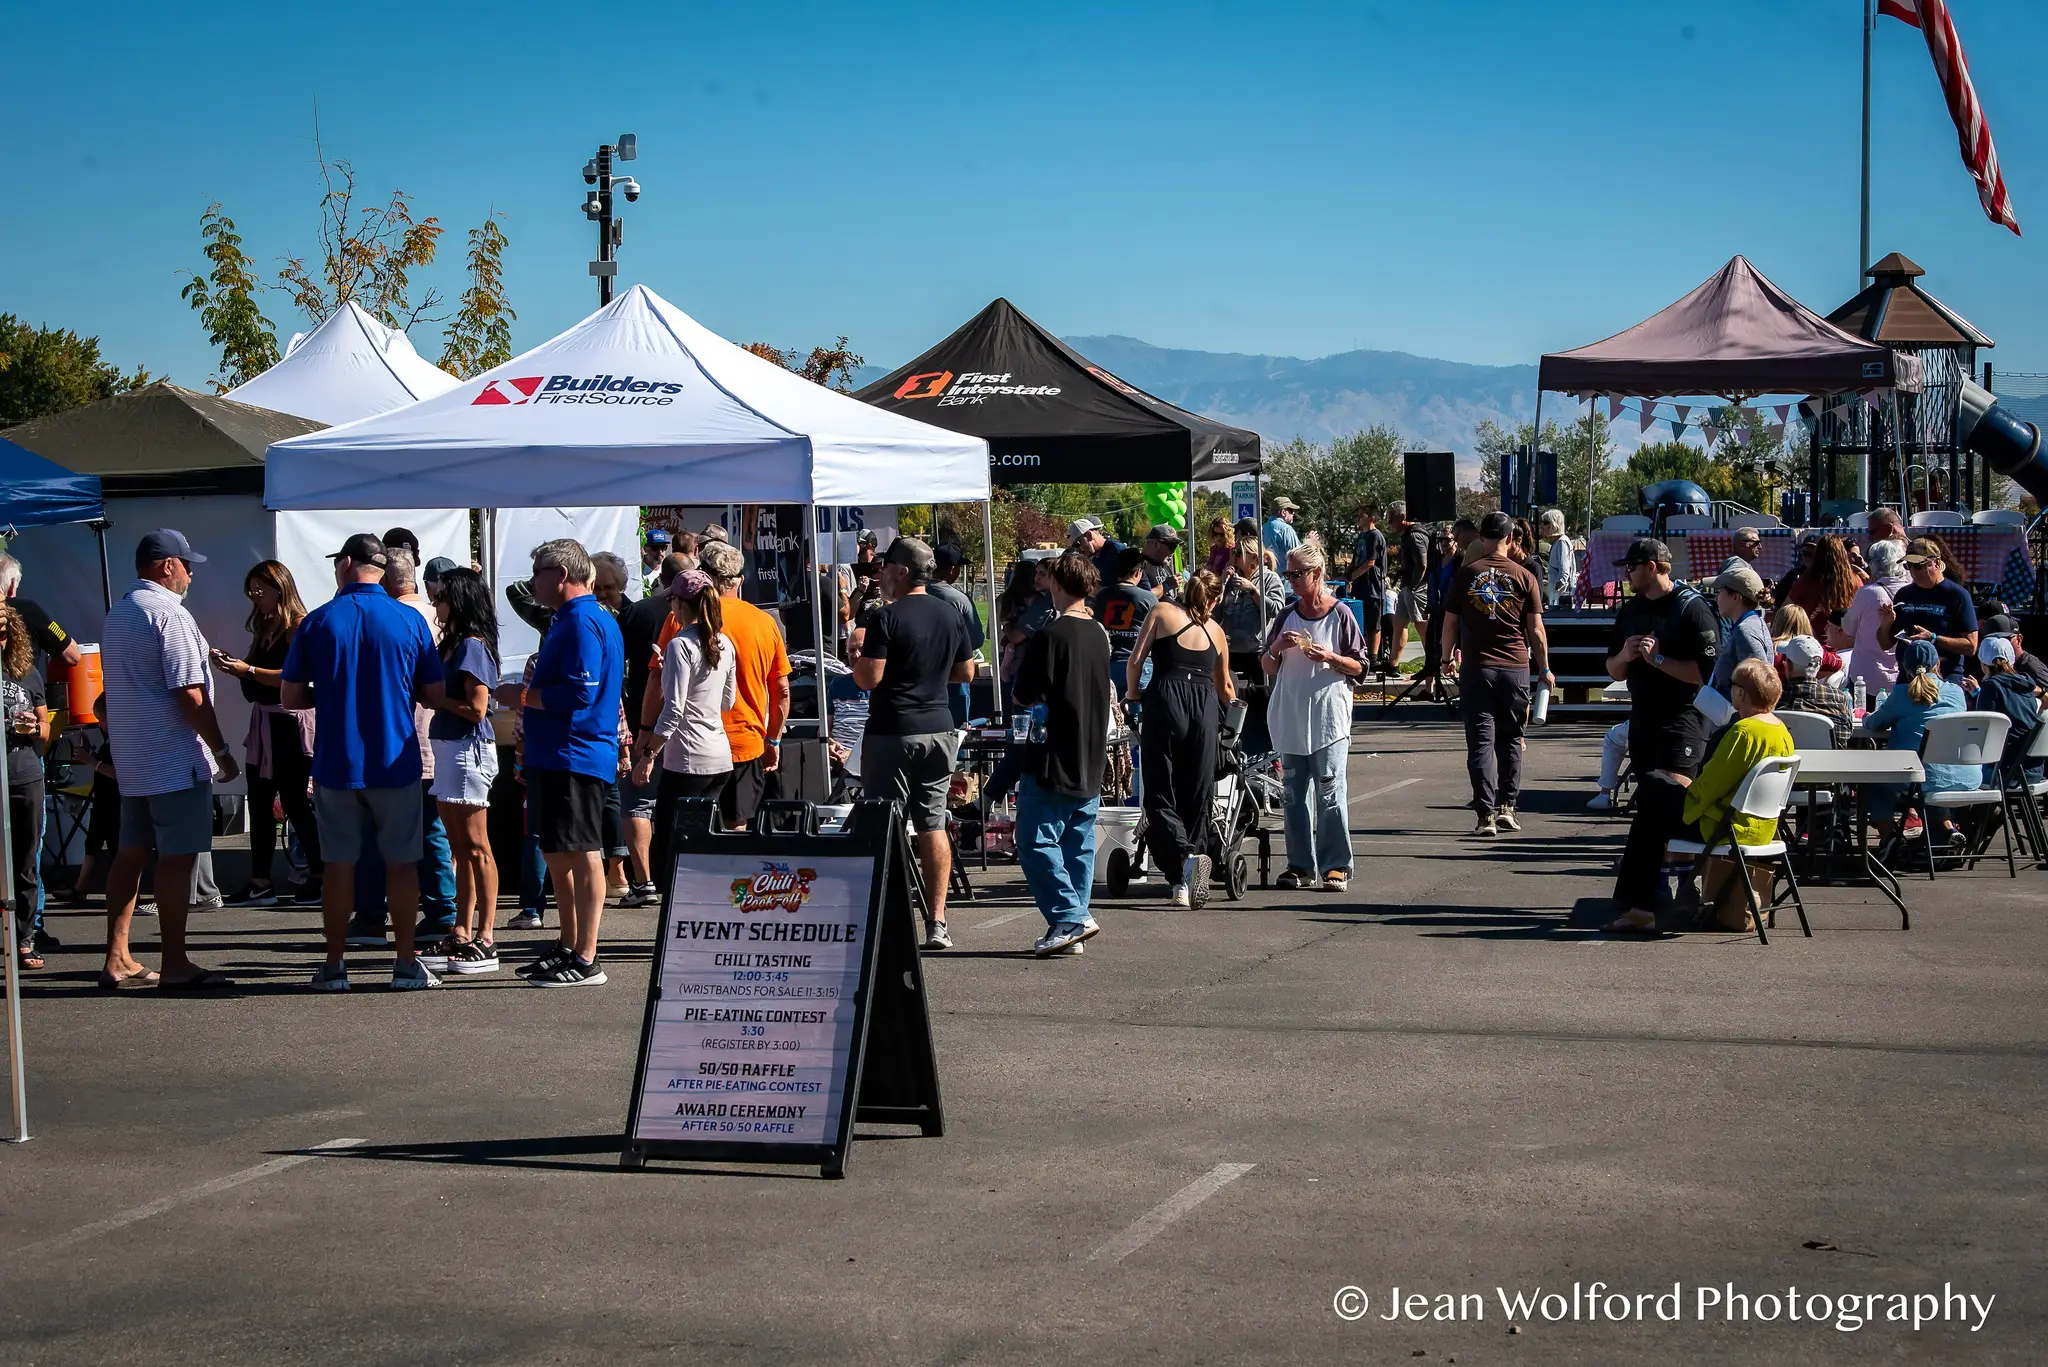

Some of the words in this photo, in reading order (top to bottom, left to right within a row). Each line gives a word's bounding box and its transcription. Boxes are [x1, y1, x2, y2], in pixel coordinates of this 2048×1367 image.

[542, 374, 684, 394] Builders
[955, 372, 1011, 385] First
[948, 384, 1062, 396] Interstate
[533, 392, 674, 406] FirstSource
[937, 395, 988, 407] Bank
[757, 508, 776, 528] Firs
[753, 874, 794, 893] Chili
[741, 893, 801, 910] Cook-off
[675, 921, 745, 940] EVENT
[748, 922, 857, 943] SCHEDULE
[714, 953, 751, 967] CHILI
[754, 954, 811, 968] TASTING
[733, 971, 789, 982] 12:00-3:45
[679, 983, 752, 996] (WRISTBANDS
[753, 986, 776, 996] FOR
[778, 987, 803, 997] SALE
[805, 986, 839, 999] 11-3:15)
[684, 1008, 763, 1022] PIE-EATING
[766, 1010, 827, 1024] CONTEST
[740, 1026, 765, 1036] 3:30
[701, 1037, 756, 1050] (REGISTER
[758, 1040, 770, 1050] BY
[772, 1040, 801, 1051] 3:00)
[698, 1062, 738, 1076] 50/50
[741, 1063, 796, 1077] RAFFLE
[667, 1079, 703, 1089] AFTER
[705, 1080, 767, 1092] PIE-EATING
[768, 1081, 822, 1093] CONTEST
[675, 1103, 727, 1117] AWARD
[729, 1104, 806, 1119] CEREMONY
[681, 1121, 717, 1131] AFTER
[719, 1121, 751, 1133] 50/50
[753, 1123, 795, 1134] RAFFLE
